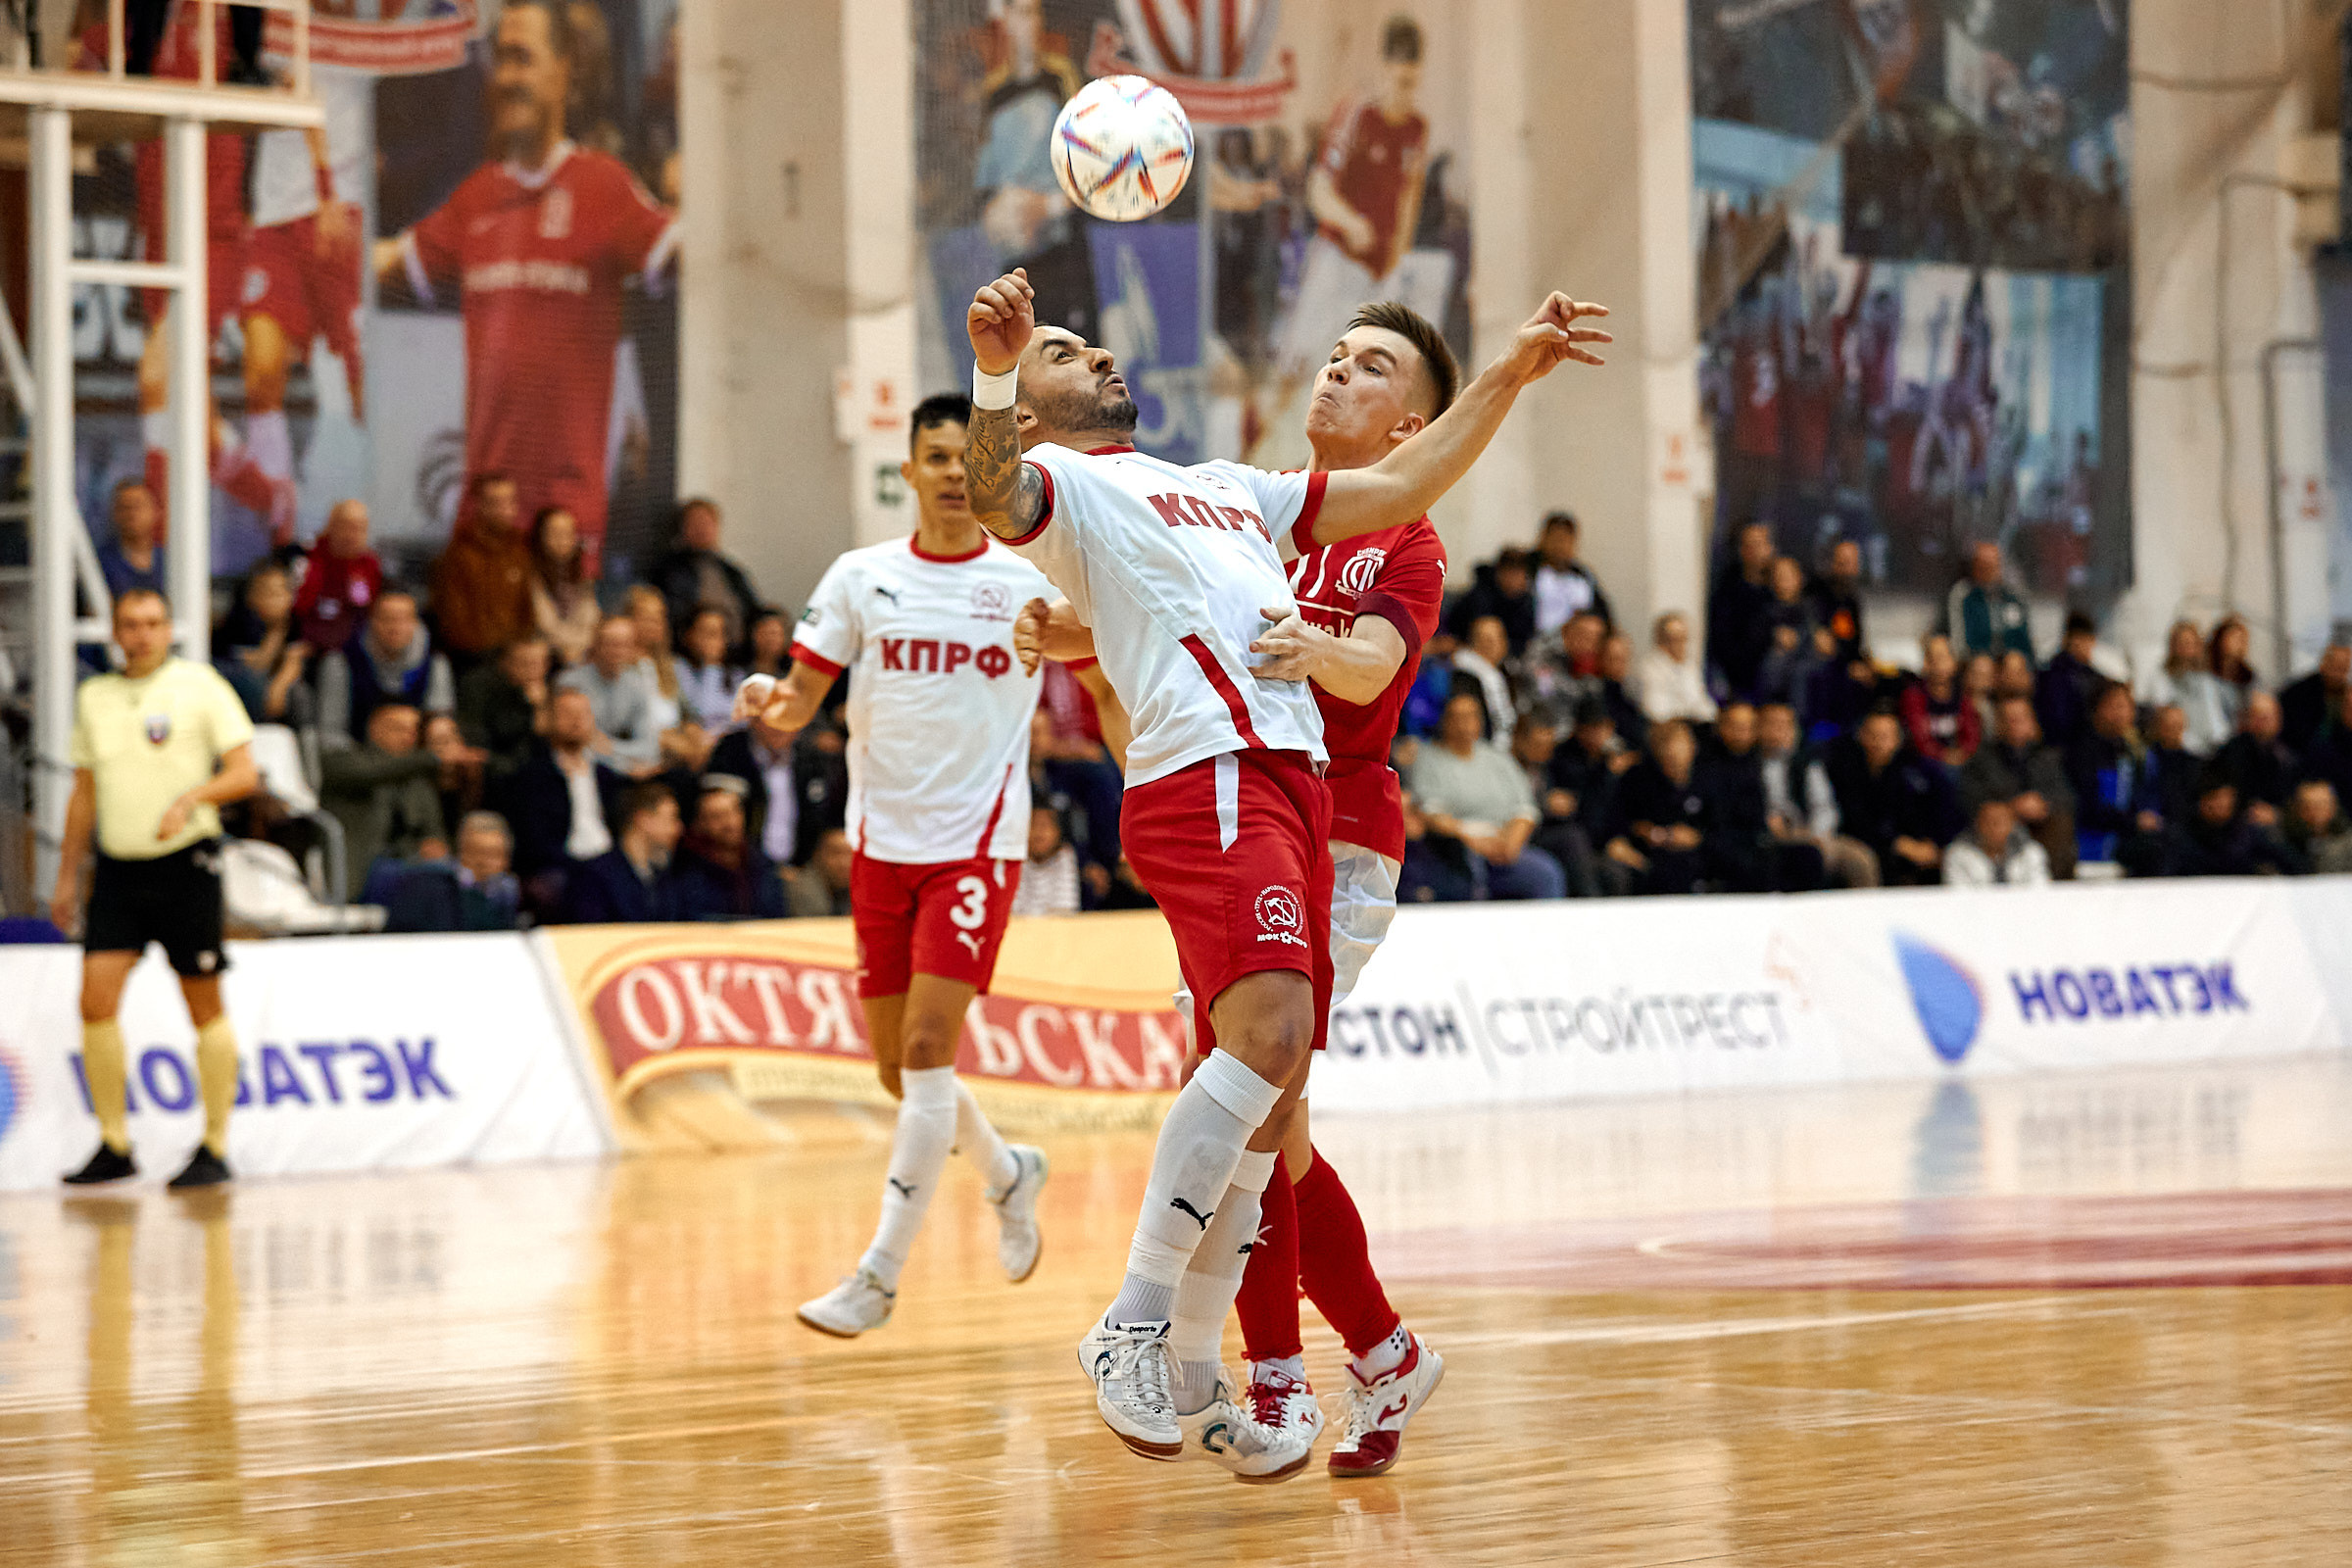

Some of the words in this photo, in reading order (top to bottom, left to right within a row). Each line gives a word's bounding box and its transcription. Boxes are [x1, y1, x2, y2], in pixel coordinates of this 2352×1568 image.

[880, 638, 1011, 679] КПРФ
[949, 875, 988, 930] 3
[2005, 956, 2252, 1024] НОВАТЭК
[1327, 1001, 1470, 1059] СТОН
[1482, 984, 1790, 1057] СТРОЙТРЕСТ
